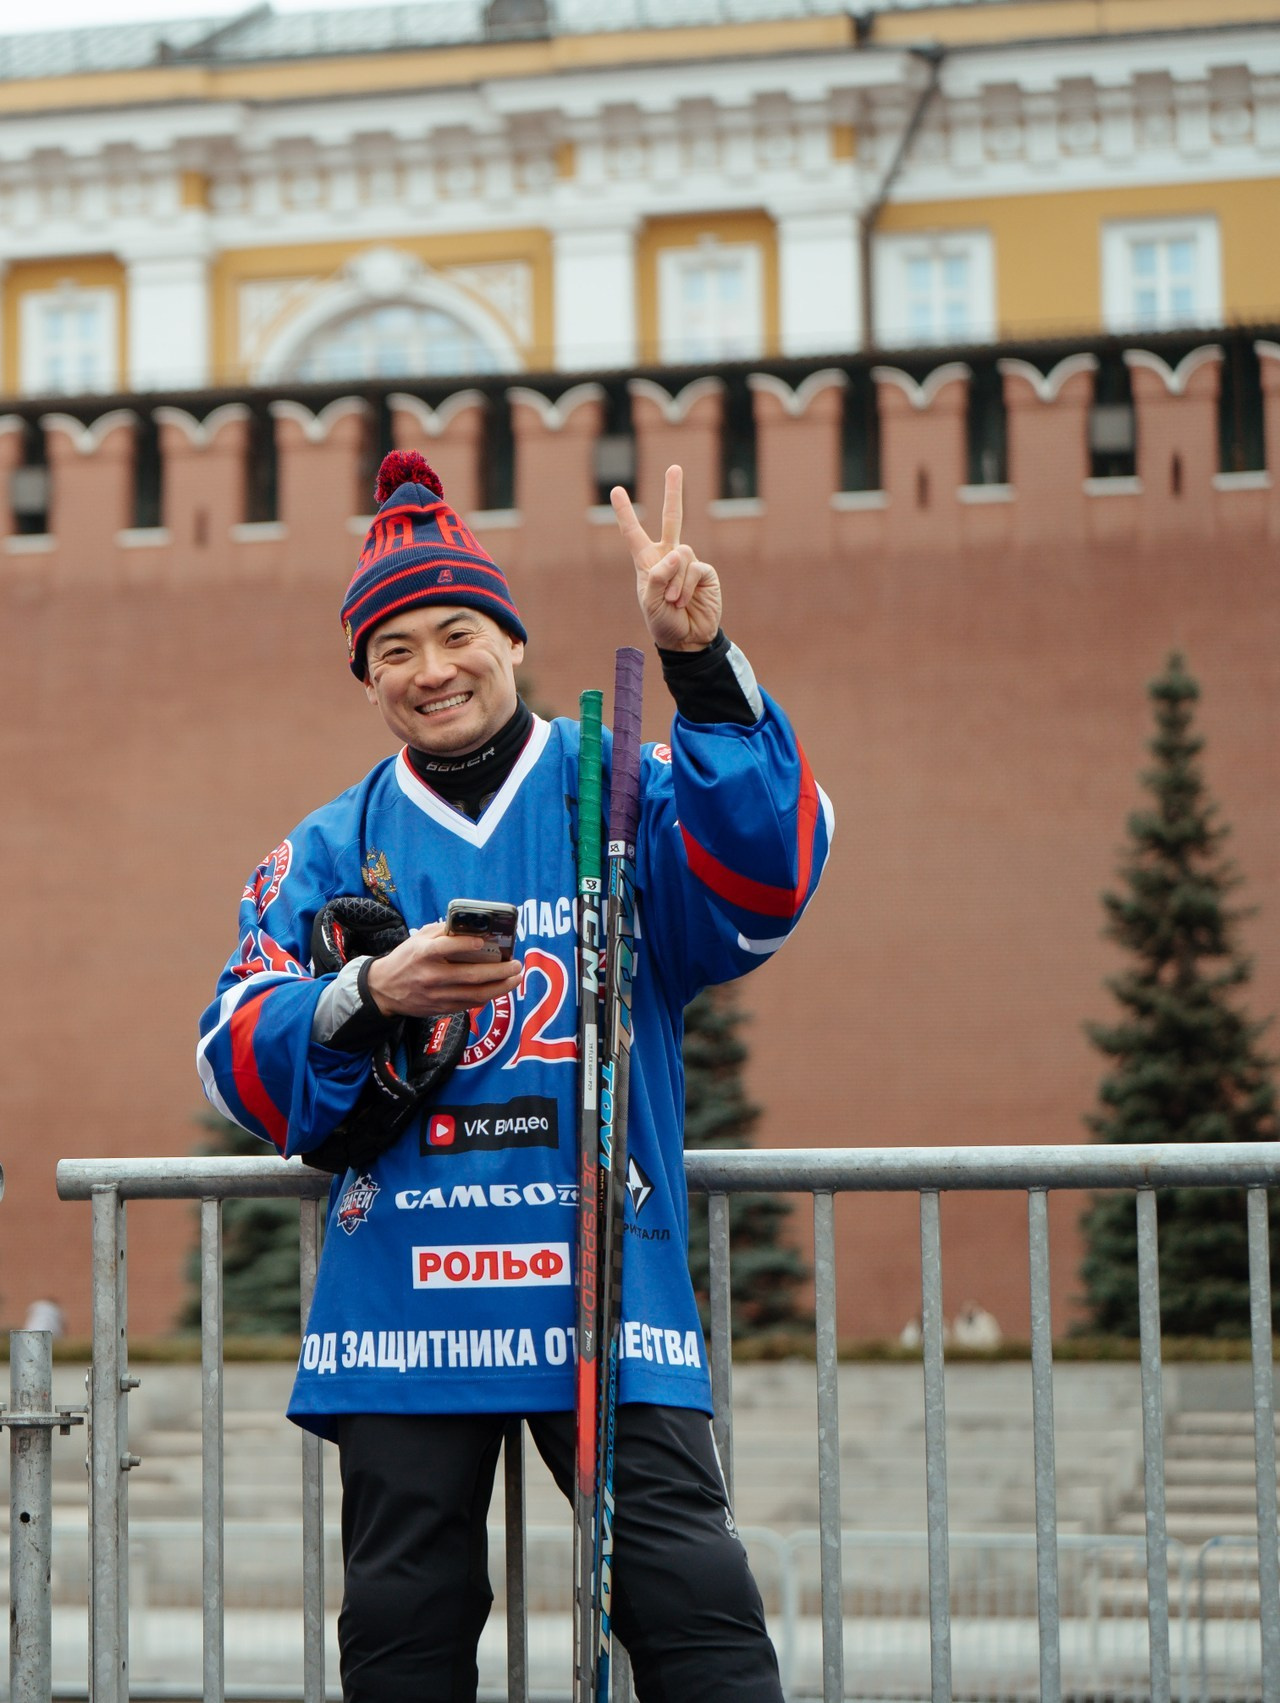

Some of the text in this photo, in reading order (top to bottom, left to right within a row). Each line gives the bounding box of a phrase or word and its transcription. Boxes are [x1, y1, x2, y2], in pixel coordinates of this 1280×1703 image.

[464, 1119, 490, 1137] VK
[580, 1152, 598, 1311] JETSPEED
[419, 1249, 564, 1282] РОЛЬФ
[301, 1332, 337, 1375] ОД
[341, 1328, 538, 1373] ЗАЩИТНИКА
